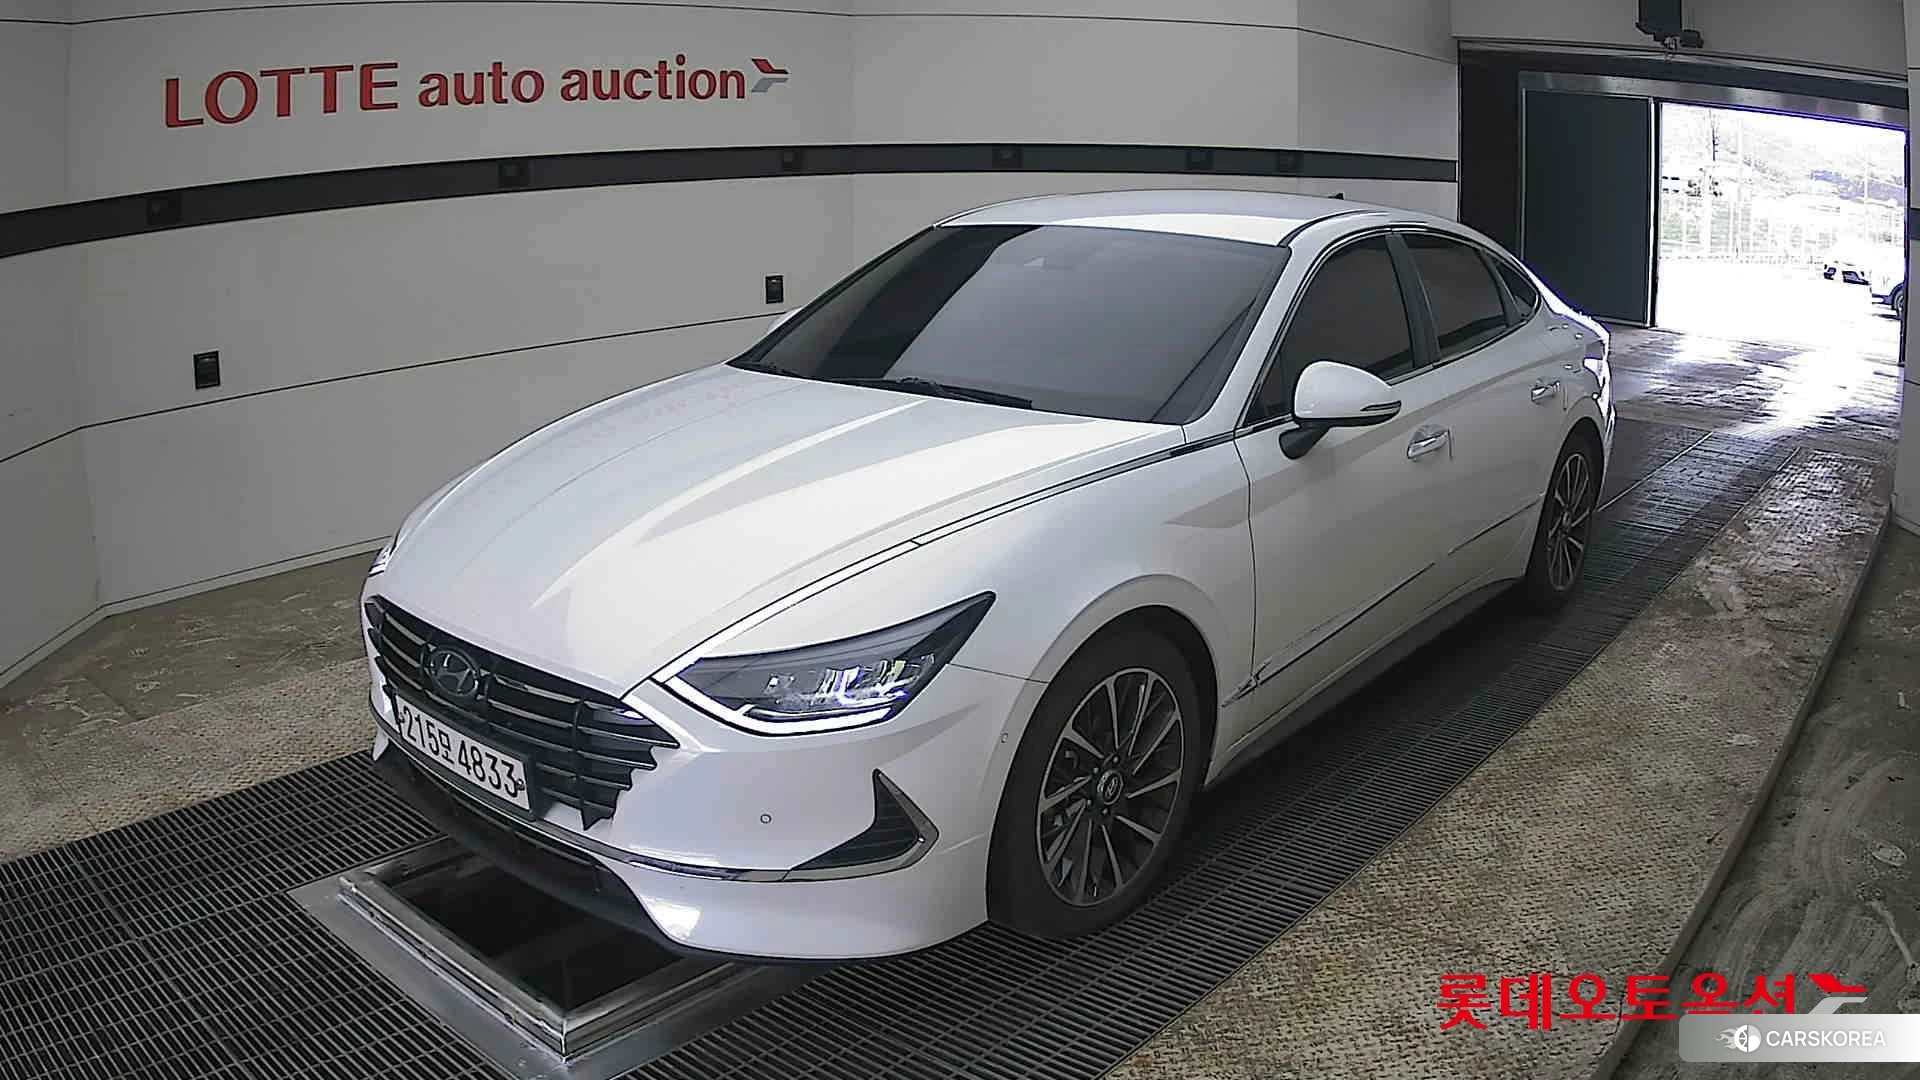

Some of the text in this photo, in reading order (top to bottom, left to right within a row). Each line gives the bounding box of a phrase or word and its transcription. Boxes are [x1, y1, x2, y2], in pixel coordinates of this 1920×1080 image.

[164, 53, 746, 128] LOTTE auto auction
[457, 740, 518, 798] 4833
